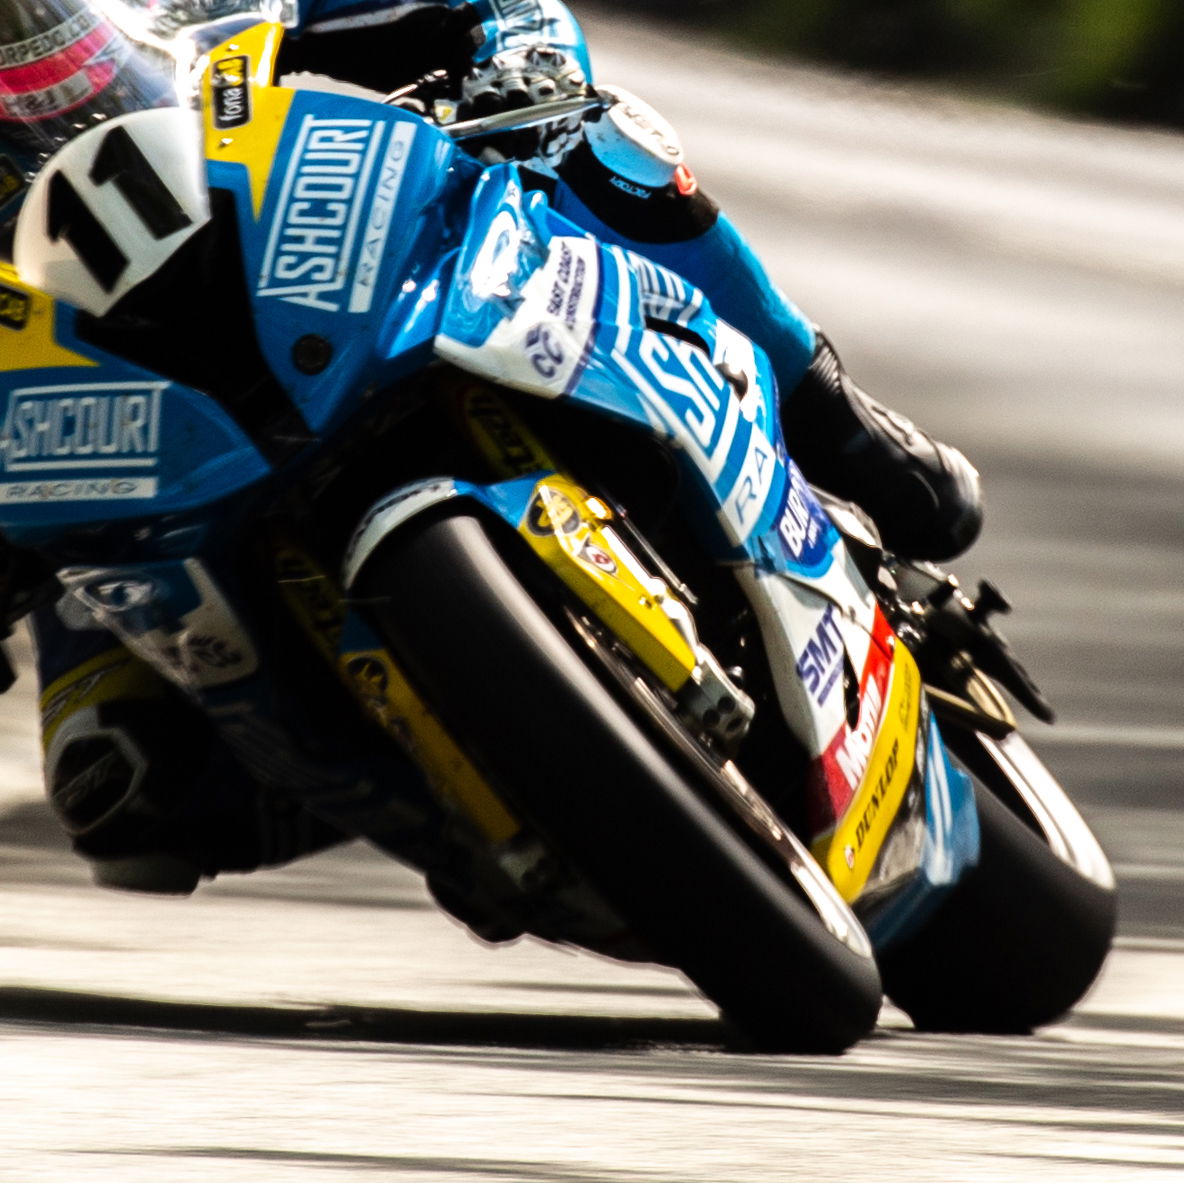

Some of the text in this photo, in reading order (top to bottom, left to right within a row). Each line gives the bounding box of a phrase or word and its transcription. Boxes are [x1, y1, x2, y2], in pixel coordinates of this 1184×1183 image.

[48, 125, 193, 294] 11
[256, 114, 372, 312] ASHCOURT
[358, 140, 404, 287] RACING
[6, 480, 138, 499] RACING
[796, 603, 844, 695] SMT
[855, 736, 899, 849] DUNLOP
